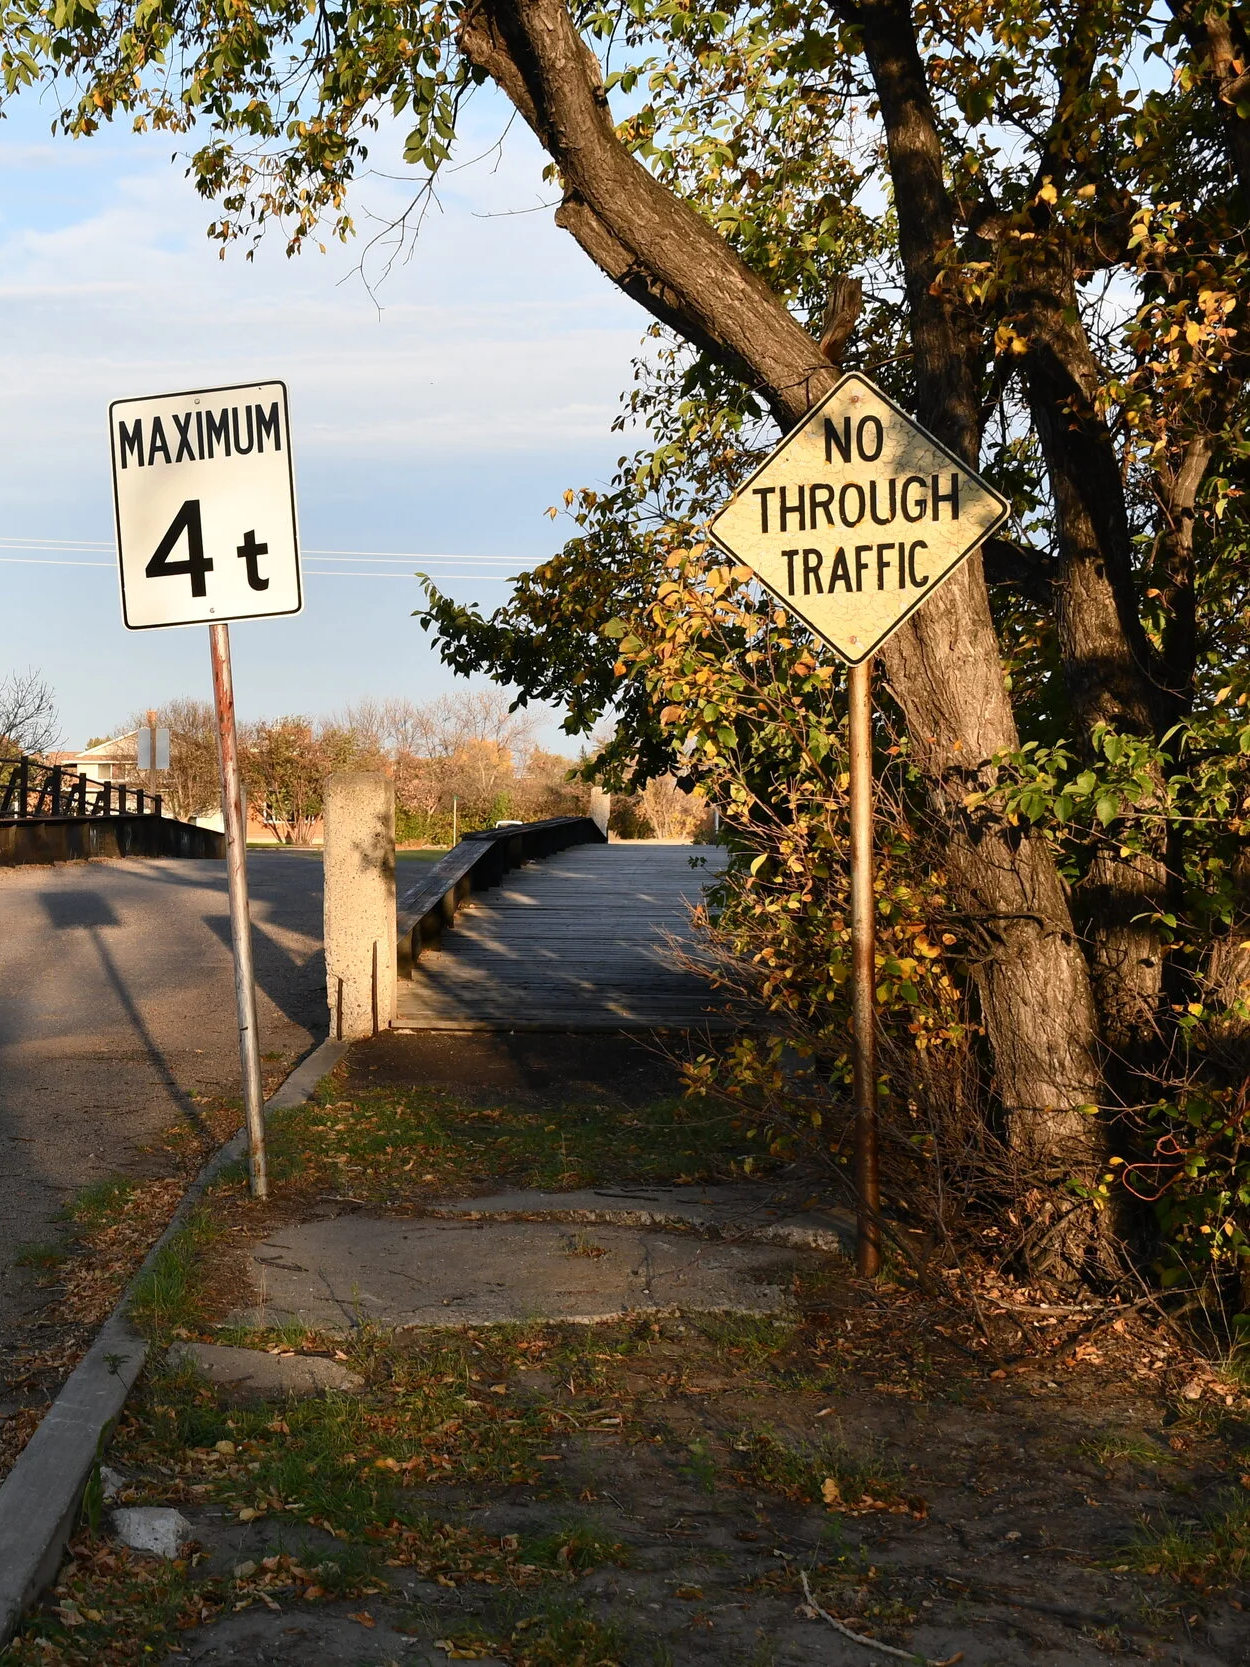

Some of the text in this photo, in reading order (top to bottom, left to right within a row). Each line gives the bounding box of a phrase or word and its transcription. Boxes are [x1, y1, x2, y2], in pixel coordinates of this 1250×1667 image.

[119, 402, 281, 469] MAXIMUM
[824, 415, 883, 464] NO
[752, 473, 960, 534] THROUGH
[145, 499, 270, 597] 4 t
[781, 539, 929, 596] TRAFFIC
